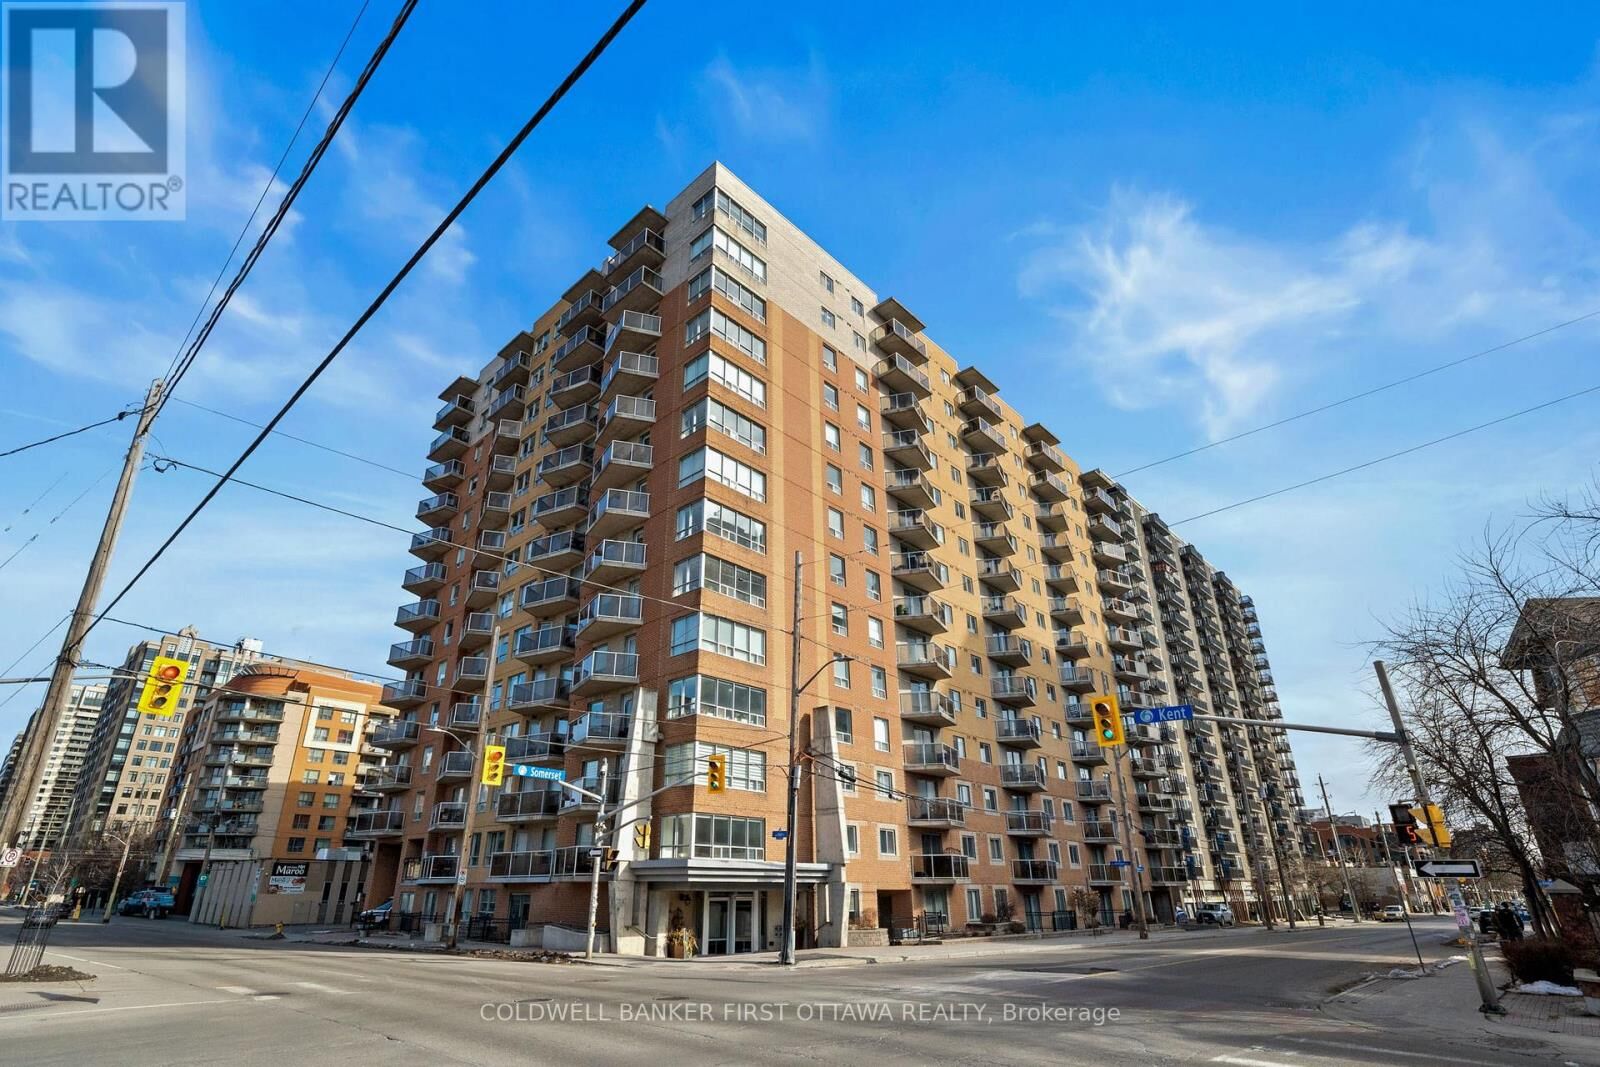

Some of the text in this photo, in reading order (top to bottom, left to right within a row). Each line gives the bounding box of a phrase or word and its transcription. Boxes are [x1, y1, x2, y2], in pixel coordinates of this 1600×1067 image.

[1159, 707, 1187, 721] Kent
[530, 767, 561, 780] Somerset
[1406, 825, 1417, 842] 5
[276, 865, 304, 875] Maroo
